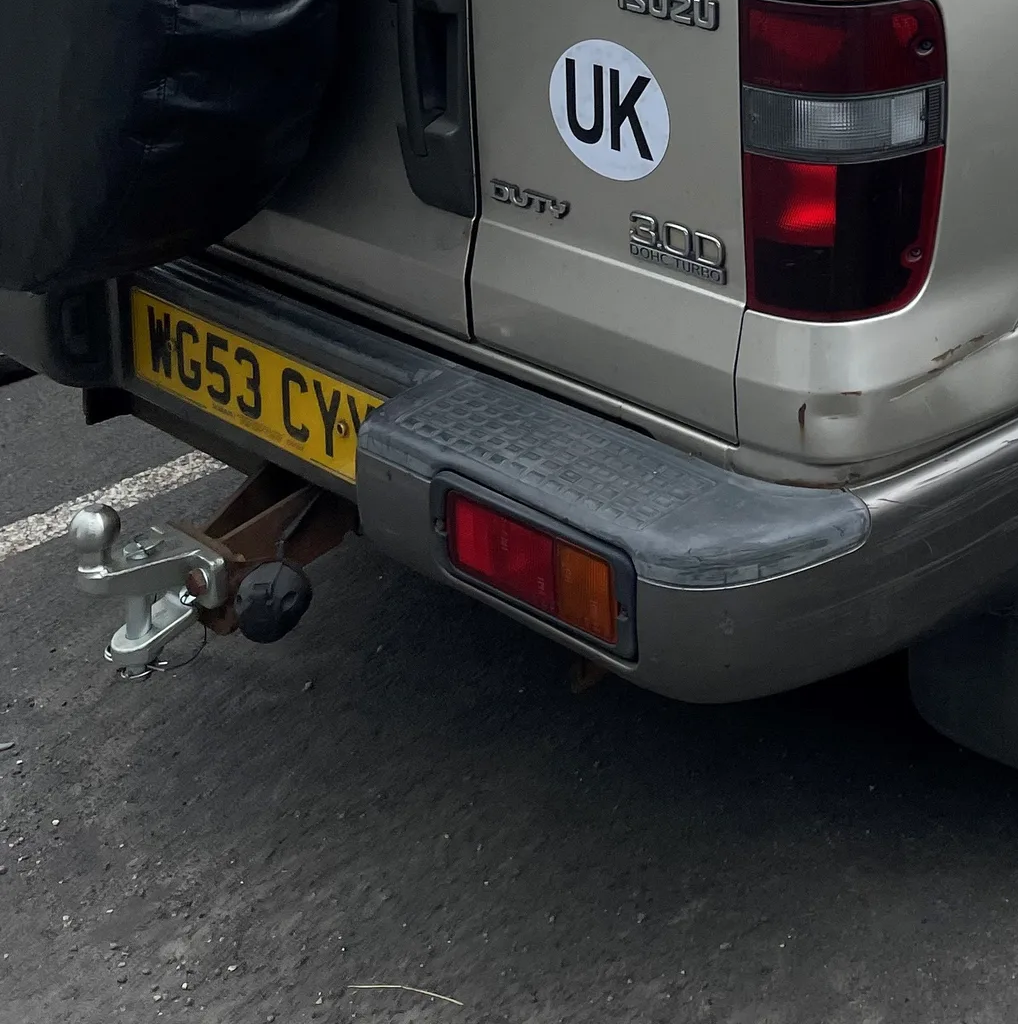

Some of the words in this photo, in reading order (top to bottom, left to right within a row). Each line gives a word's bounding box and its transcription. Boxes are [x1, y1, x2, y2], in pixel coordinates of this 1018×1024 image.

[565, 57, 654, 162] UK
[489, 177, 571, 220] DUTY
[629, 211, 726, 268] 3.0D
[629, 243, 672, 266] DOHC
[673, 257, 722, 282] TURBO
[147, 305, 262, 420] WG53
